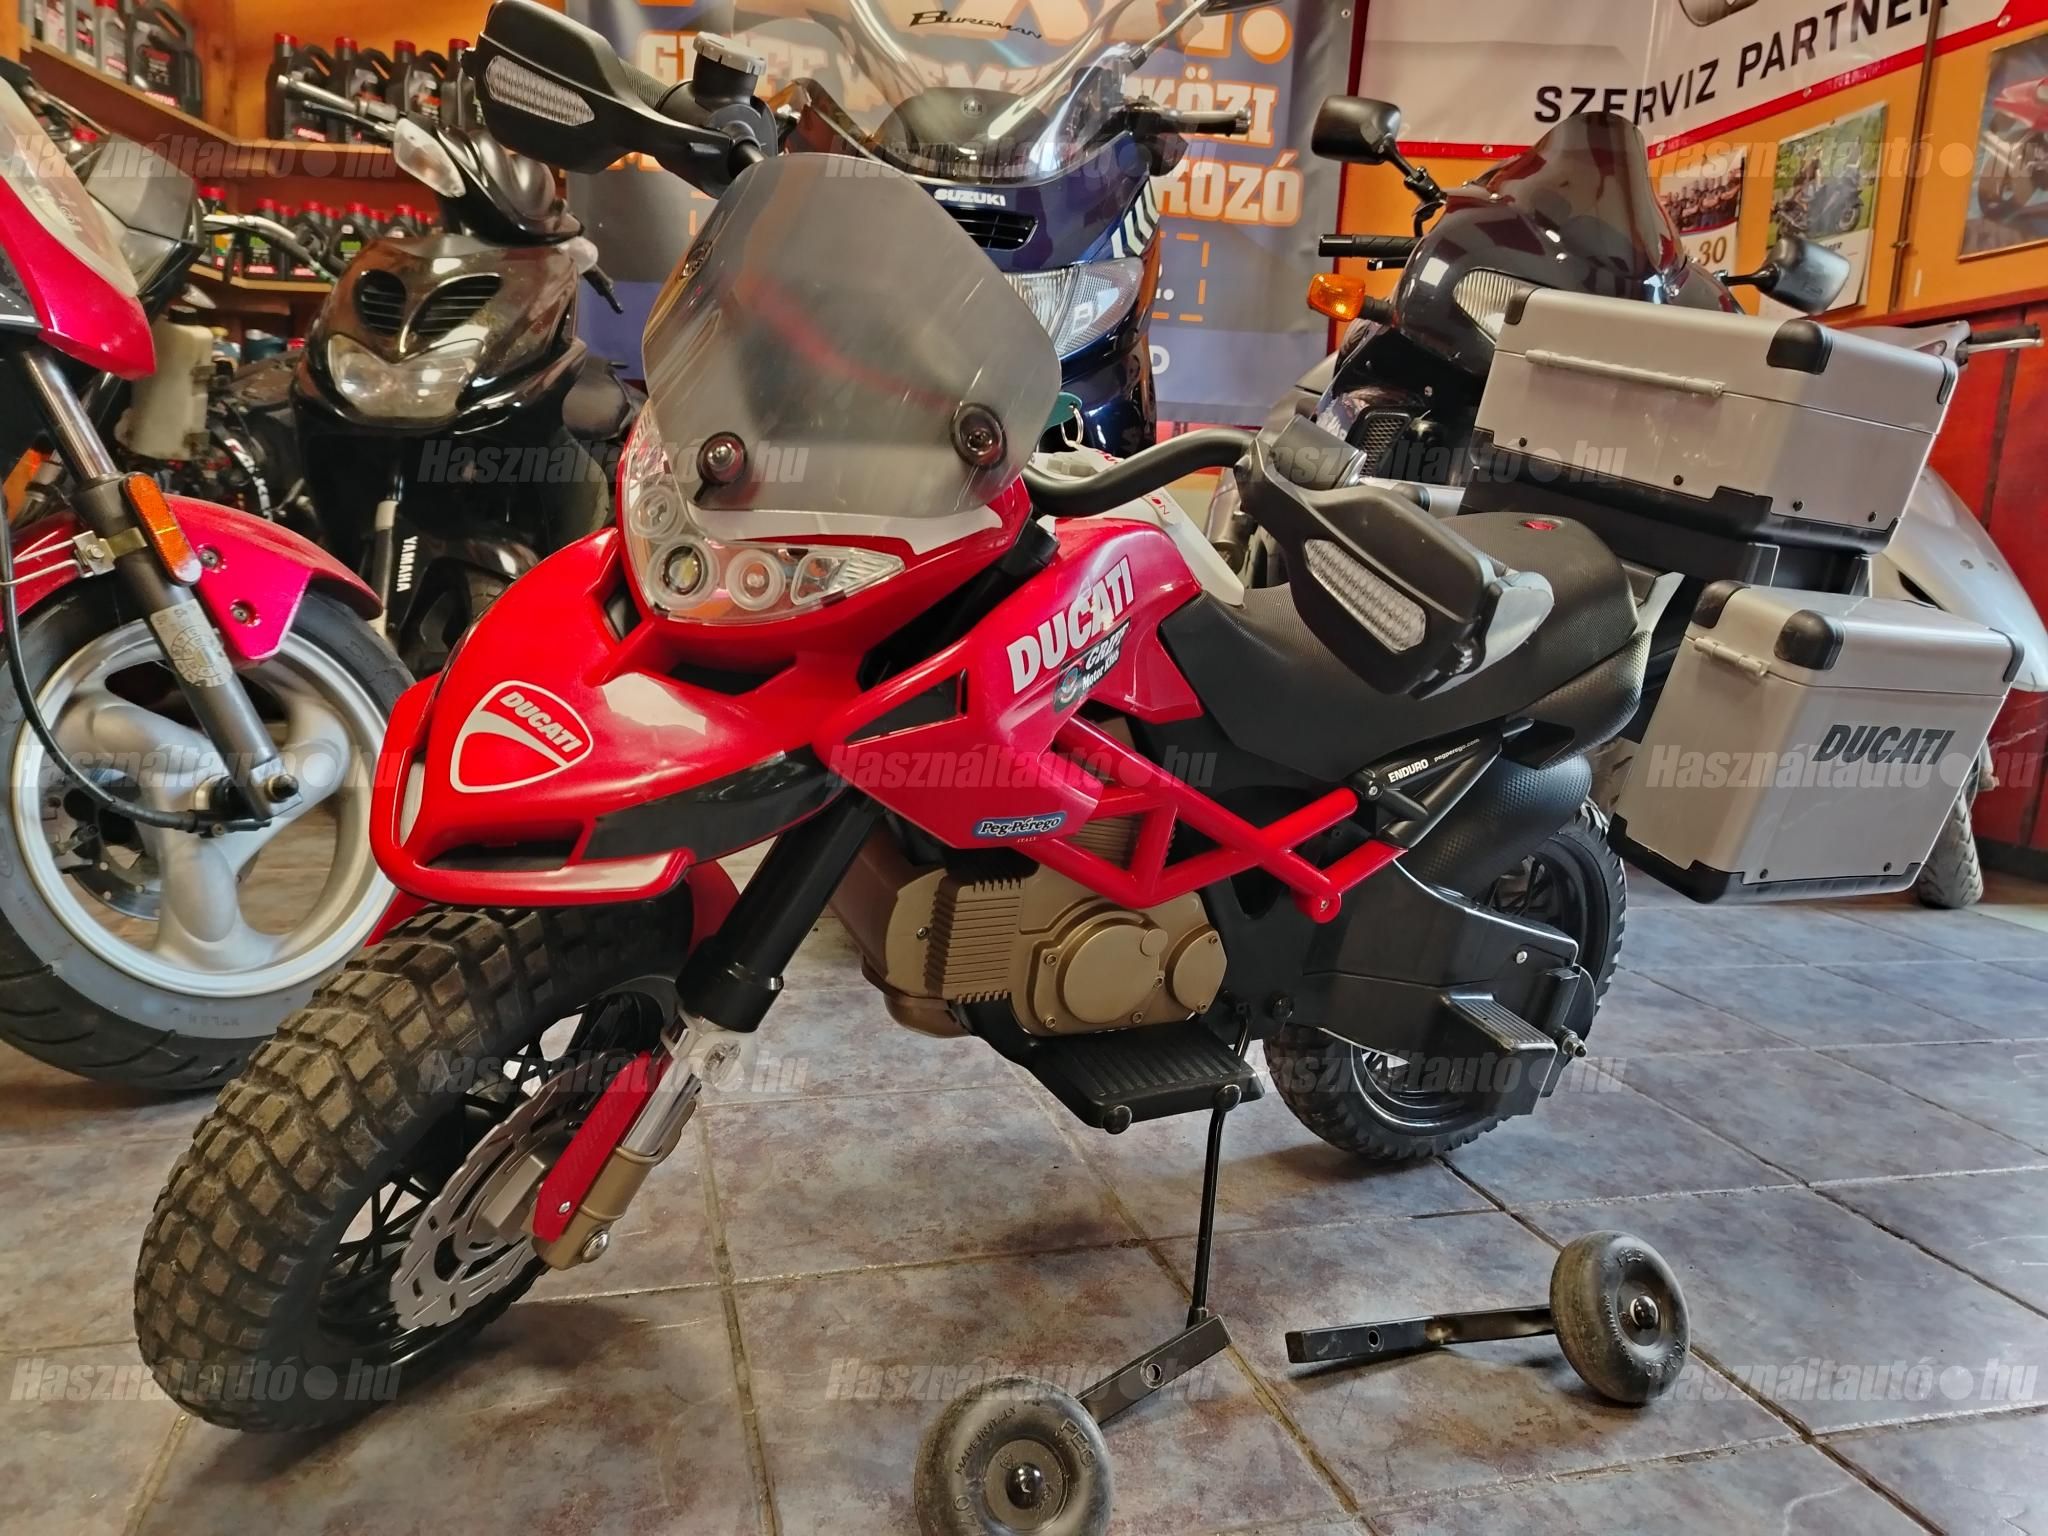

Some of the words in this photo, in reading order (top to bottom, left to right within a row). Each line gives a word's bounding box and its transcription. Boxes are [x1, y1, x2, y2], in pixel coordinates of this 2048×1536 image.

[934, 188, 1006, 207] SUZUKI
[1699, 236, 1727, 266] 30
[396, 536, 418, 592] YAMAHA
[1006, 554, 1135, 695] DUCATI
[500, 691, 583, 753] DUCATI
[1387, 758, 1429, 783] ENDURO
[1433, 738, 1480, 762] pegperego.com
[1812, 724, 1955, 766] DUCATI
[978, 817, 1061, 836] Peg-Pérego
